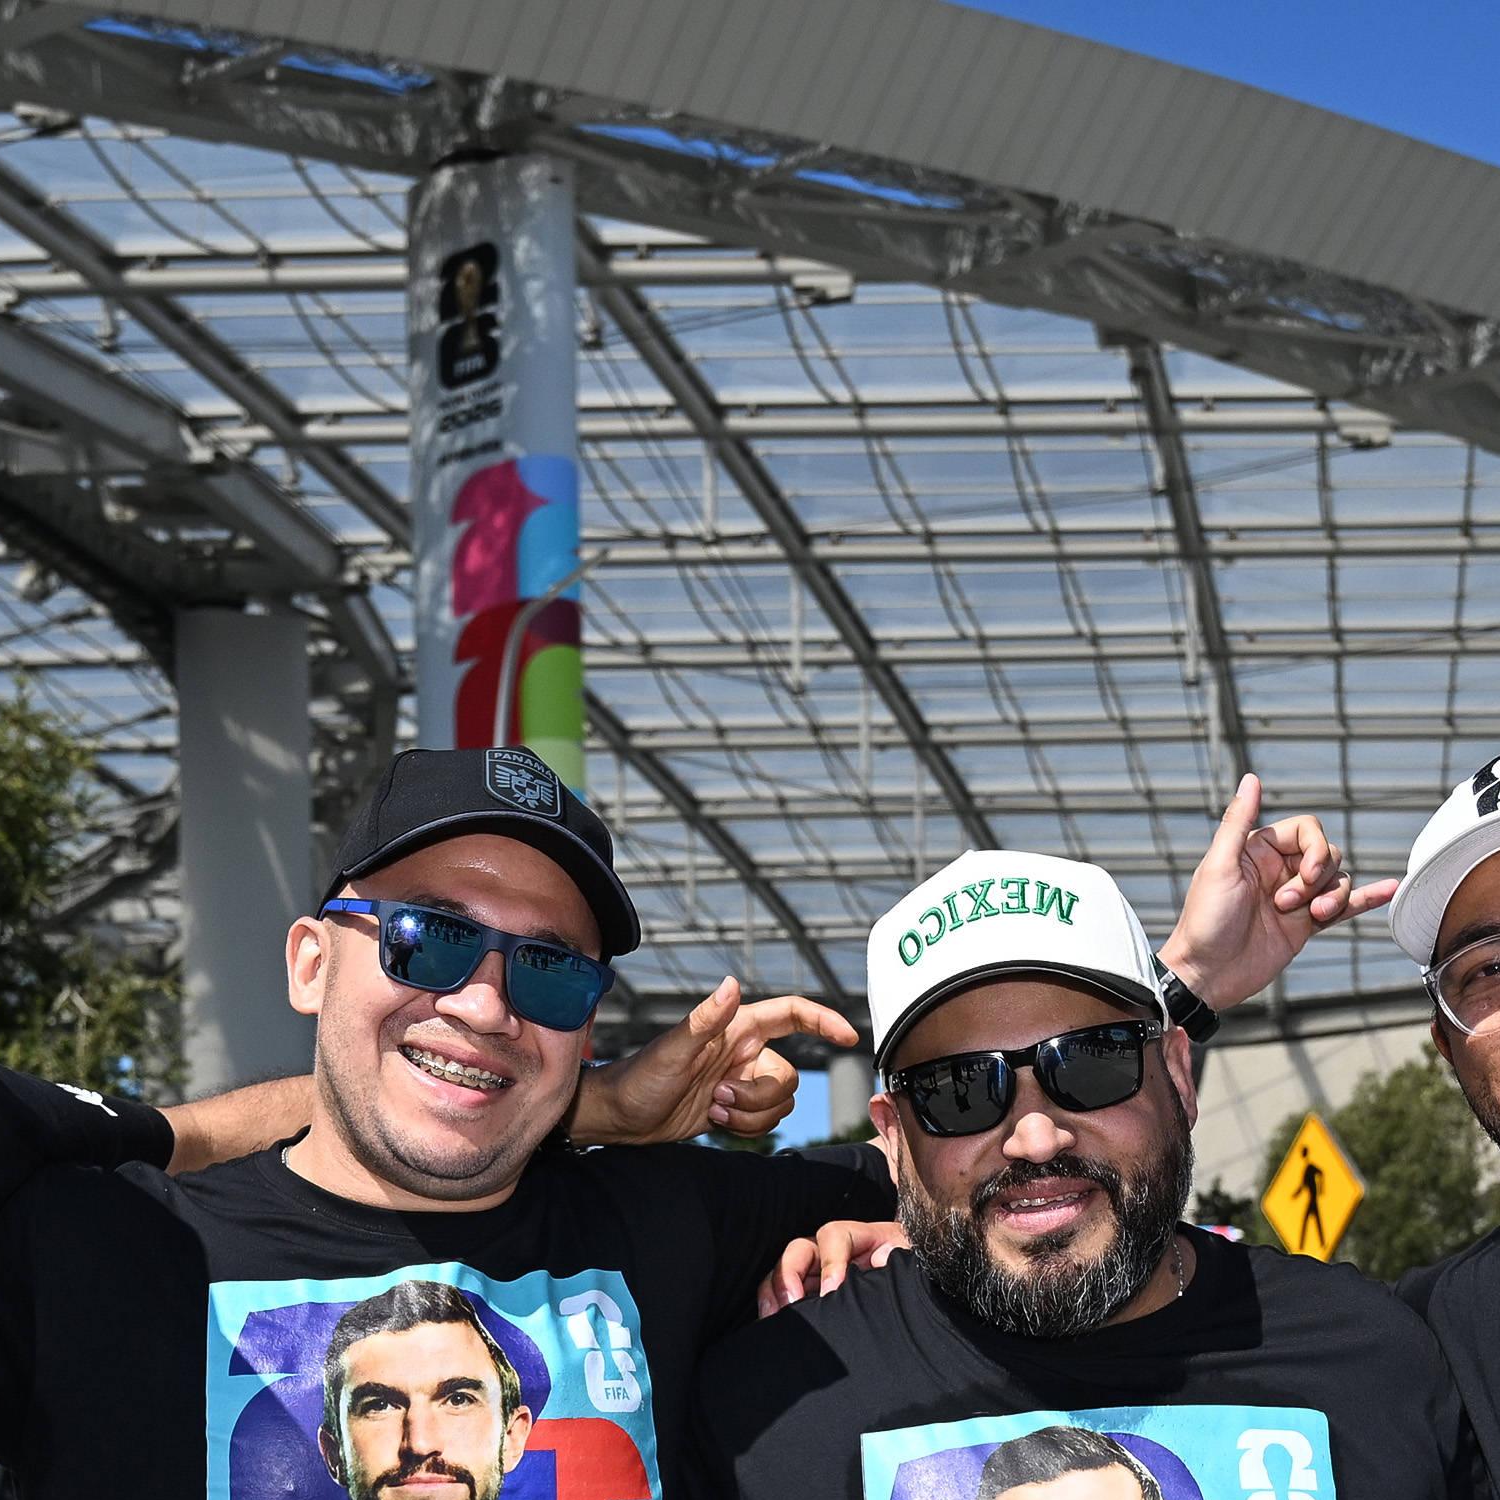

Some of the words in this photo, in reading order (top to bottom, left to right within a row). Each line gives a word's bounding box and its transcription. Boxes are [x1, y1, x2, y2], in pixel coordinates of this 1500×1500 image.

[494, 752, 553, 779] PANAMA
[899, 877, 1079, 966] MEXICO
[605, 1386, 630, 1401] FIFA
